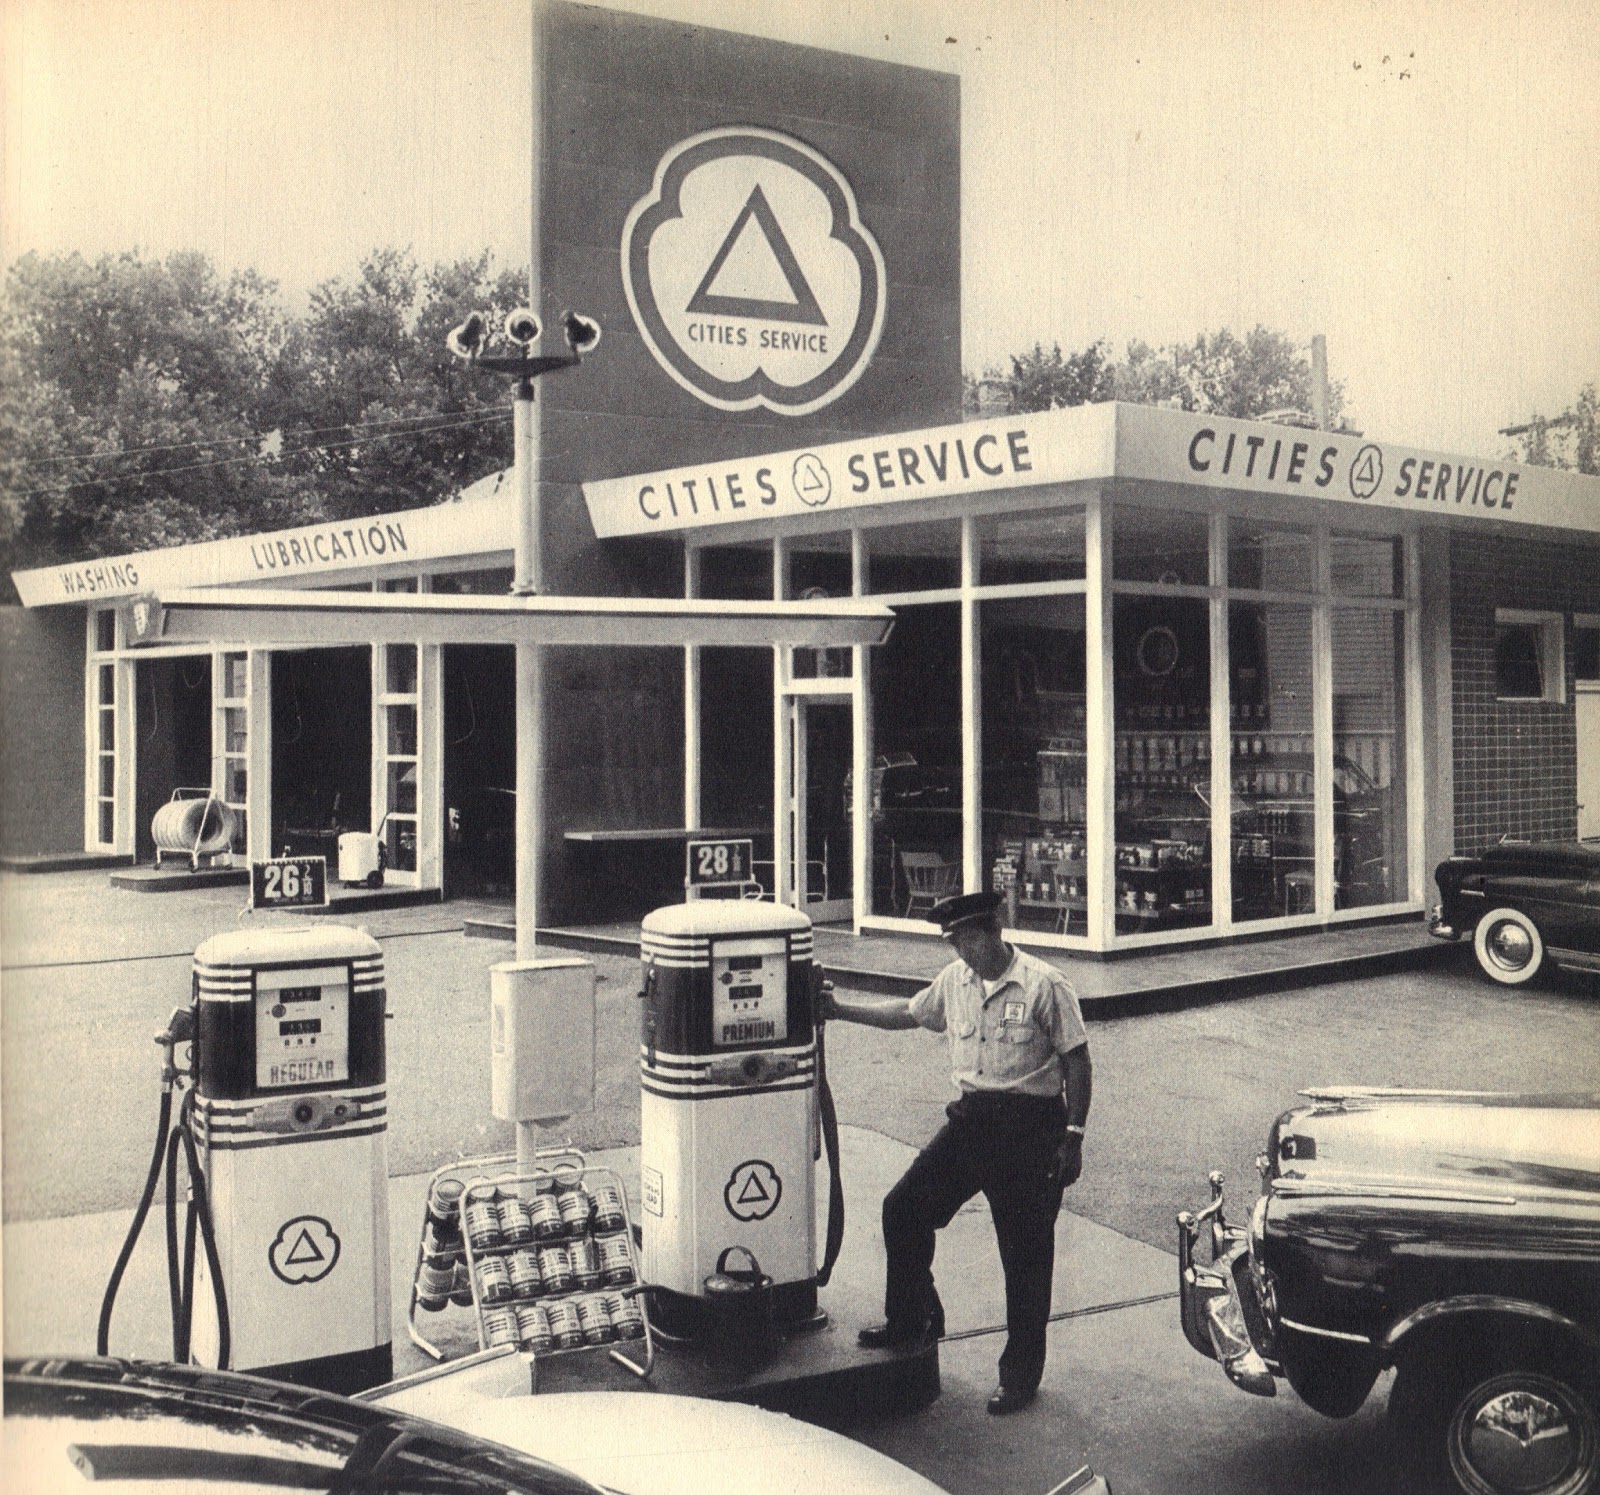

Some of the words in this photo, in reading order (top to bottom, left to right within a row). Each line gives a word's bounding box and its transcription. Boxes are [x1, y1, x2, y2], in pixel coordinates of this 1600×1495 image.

[687, 323, 748, 347] CITIES
[760, 329, 829, 353] SERVICE
[638, 467, 777, 521] CITIES
[847, 429, 1034, 493] SERVICE
[1187, 428, 1338, 488] CITIES
[1394, 457, 1521, 510] SERVICE
[250, 521, 408, 571] LUBRICATION
[59, 562, 140, 595] WASHING
[697, 845, 729, 876] 28
[263, 864, 300, 899] 26
[722, 1020, 775, 1042] PREMIUM
[270, 1060, 334, 1085] REGULAR
